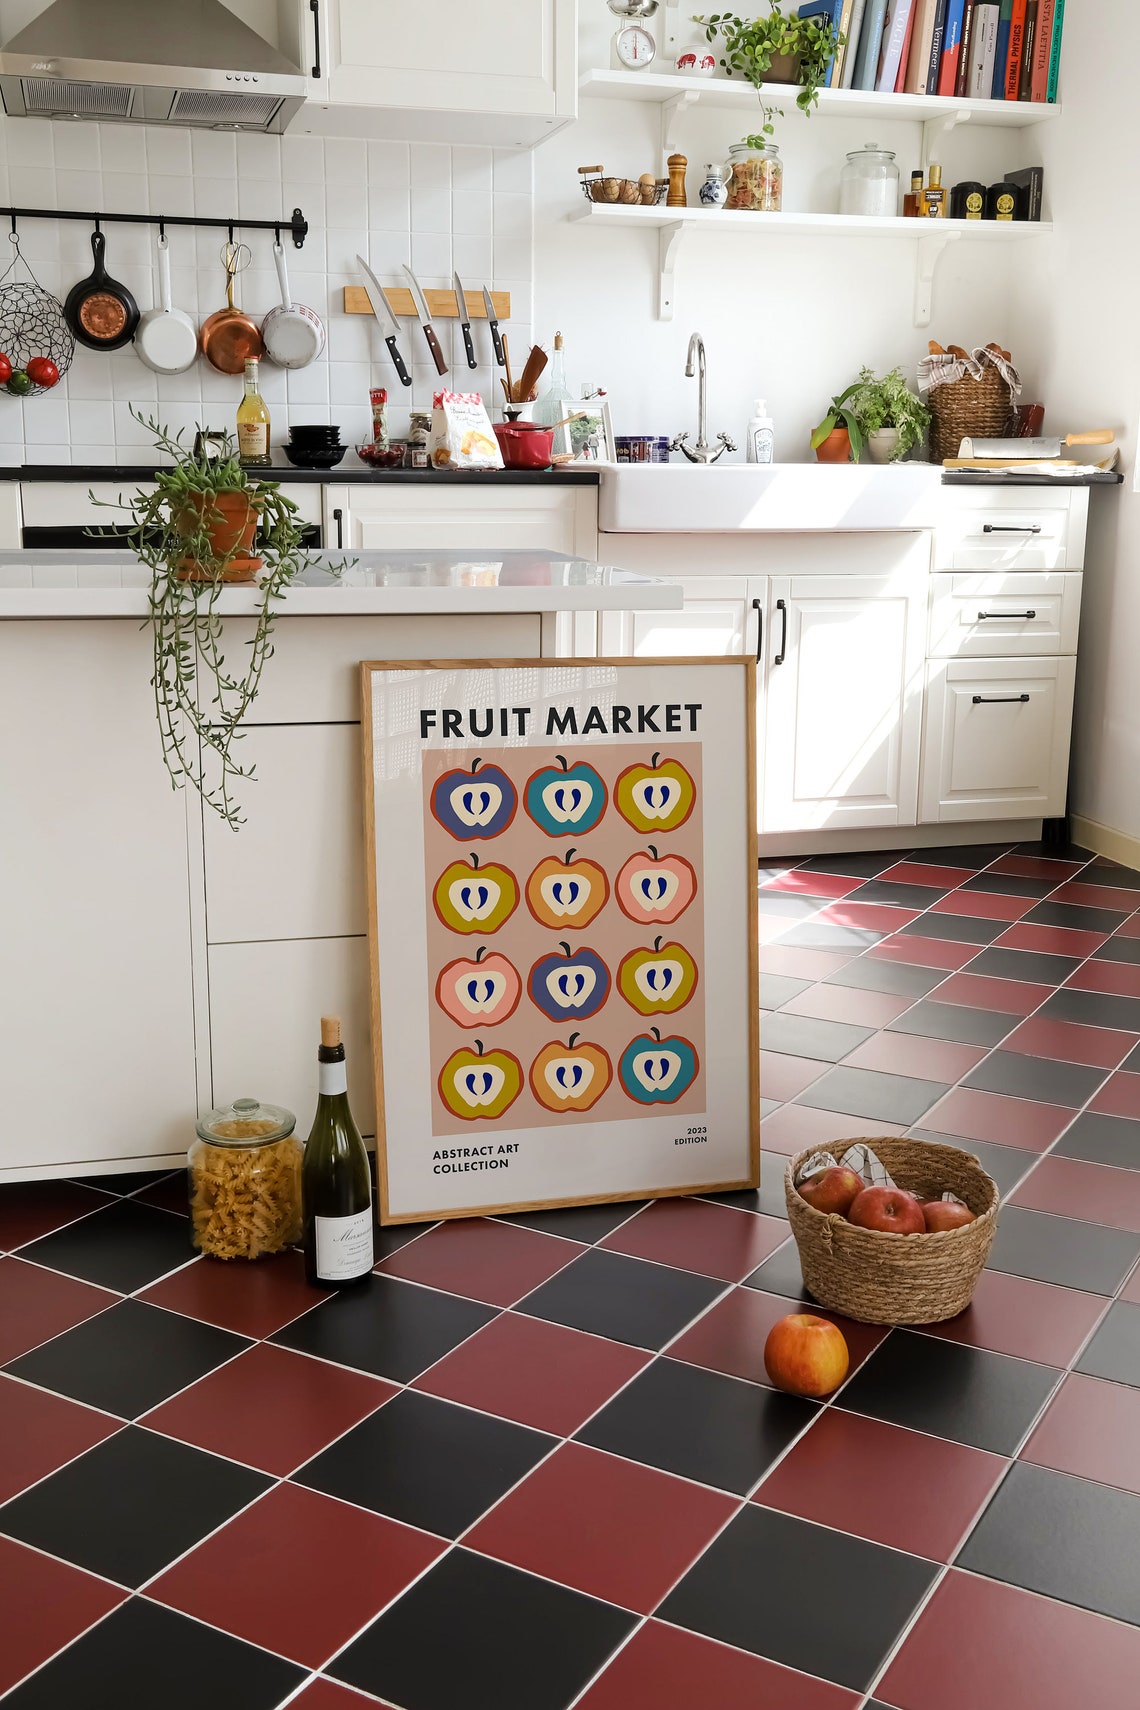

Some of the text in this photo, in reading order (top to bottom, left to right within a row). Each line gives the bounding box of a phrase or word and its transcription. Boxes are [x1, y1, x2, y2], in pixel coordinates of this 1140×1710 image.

[889, 9, 908, 58] VOGUE
[931, 26, 943, 70] Vermeer
[1038, 25, 1049, 70] LAETITIA
[1053, 25, 1061, 55] PROJECTS
[1008, 24, 1022, 95] THERMAL PHYSICS
[420, 703, 703, 739] FRUIT MARKET
[674, 1136, 708, 1146] EDITION
[687, 1126, 707, 1136] 2023
[432, 1143, 520, 1161] ABSTRACT ART
[433, 1159, 509, 1175] COLLECTION
